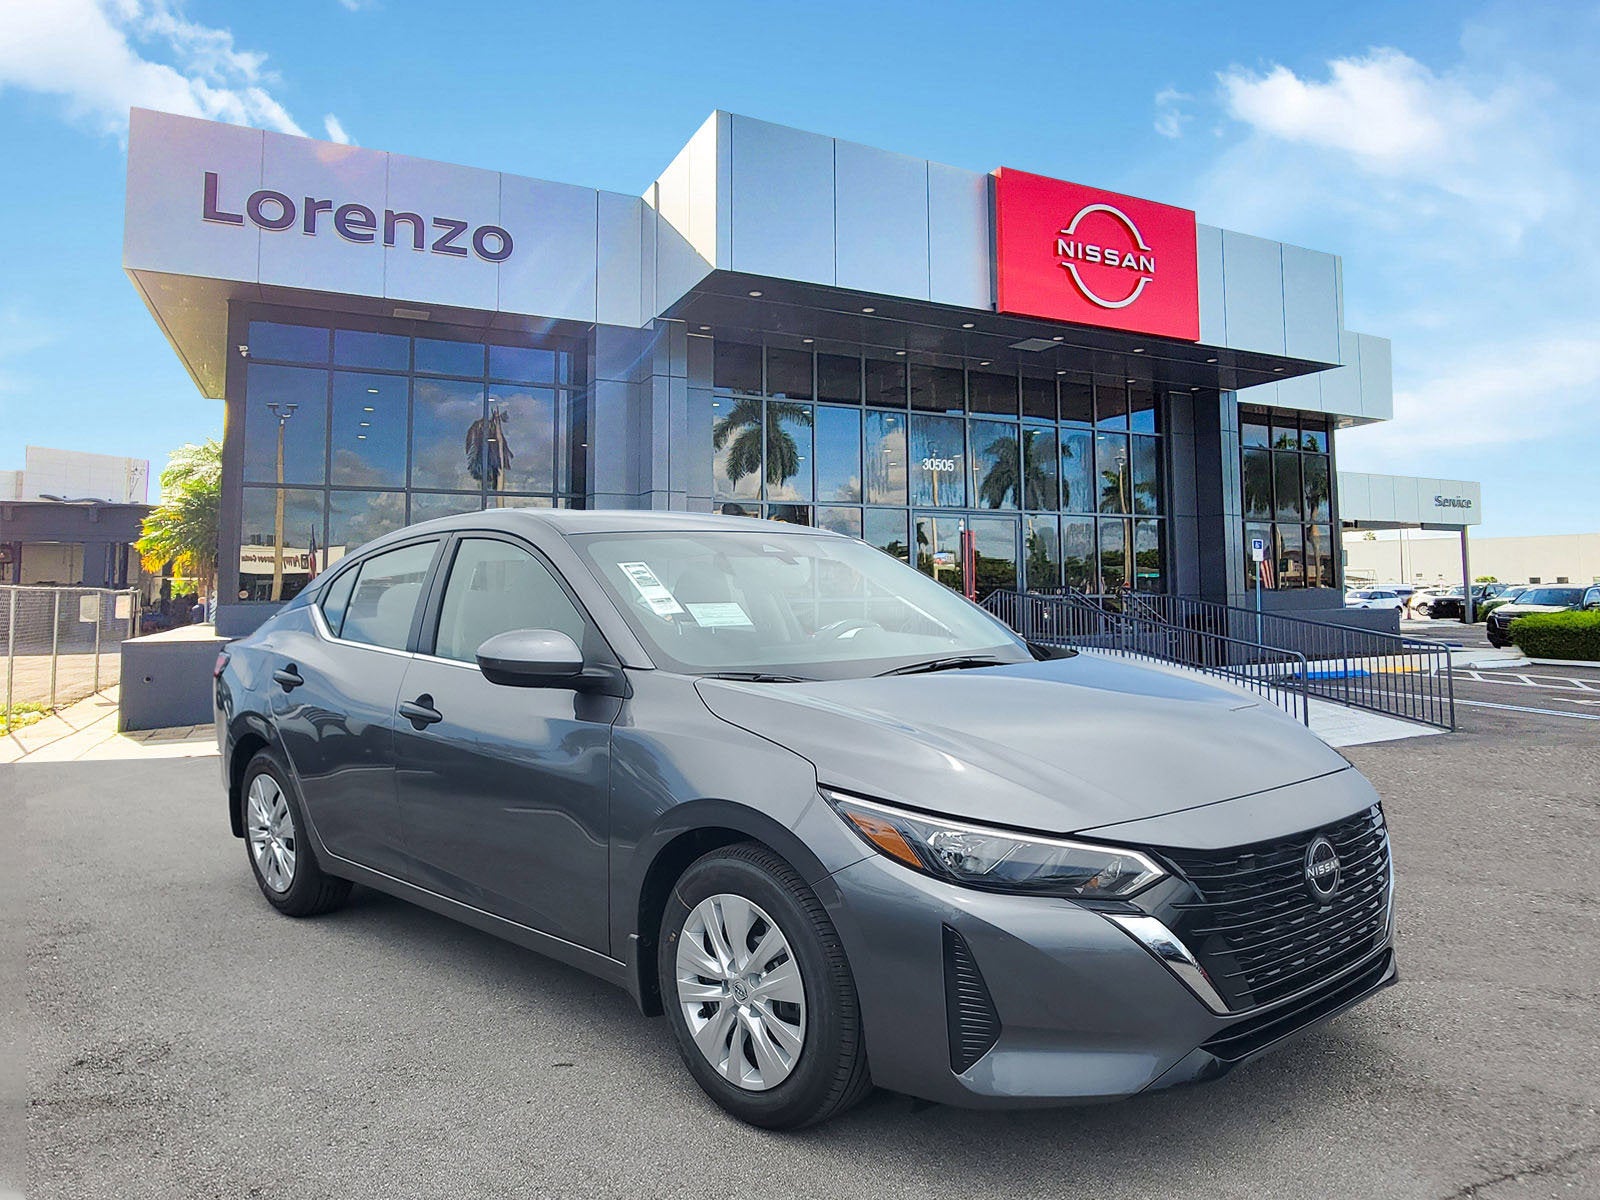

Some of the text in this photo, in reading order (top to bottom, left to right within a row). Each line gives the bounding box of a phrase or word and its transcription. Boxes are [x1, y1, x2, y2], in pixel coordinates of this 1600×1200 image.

[202, 171, 514, 262] Lorenzo
[1057, 238, 1155, 273] NISSAN
[922, 458, 954, 471] 30505
[1434, 495, 1472, 508] Service
[1307, 858, 1340, 878] NISSAN
